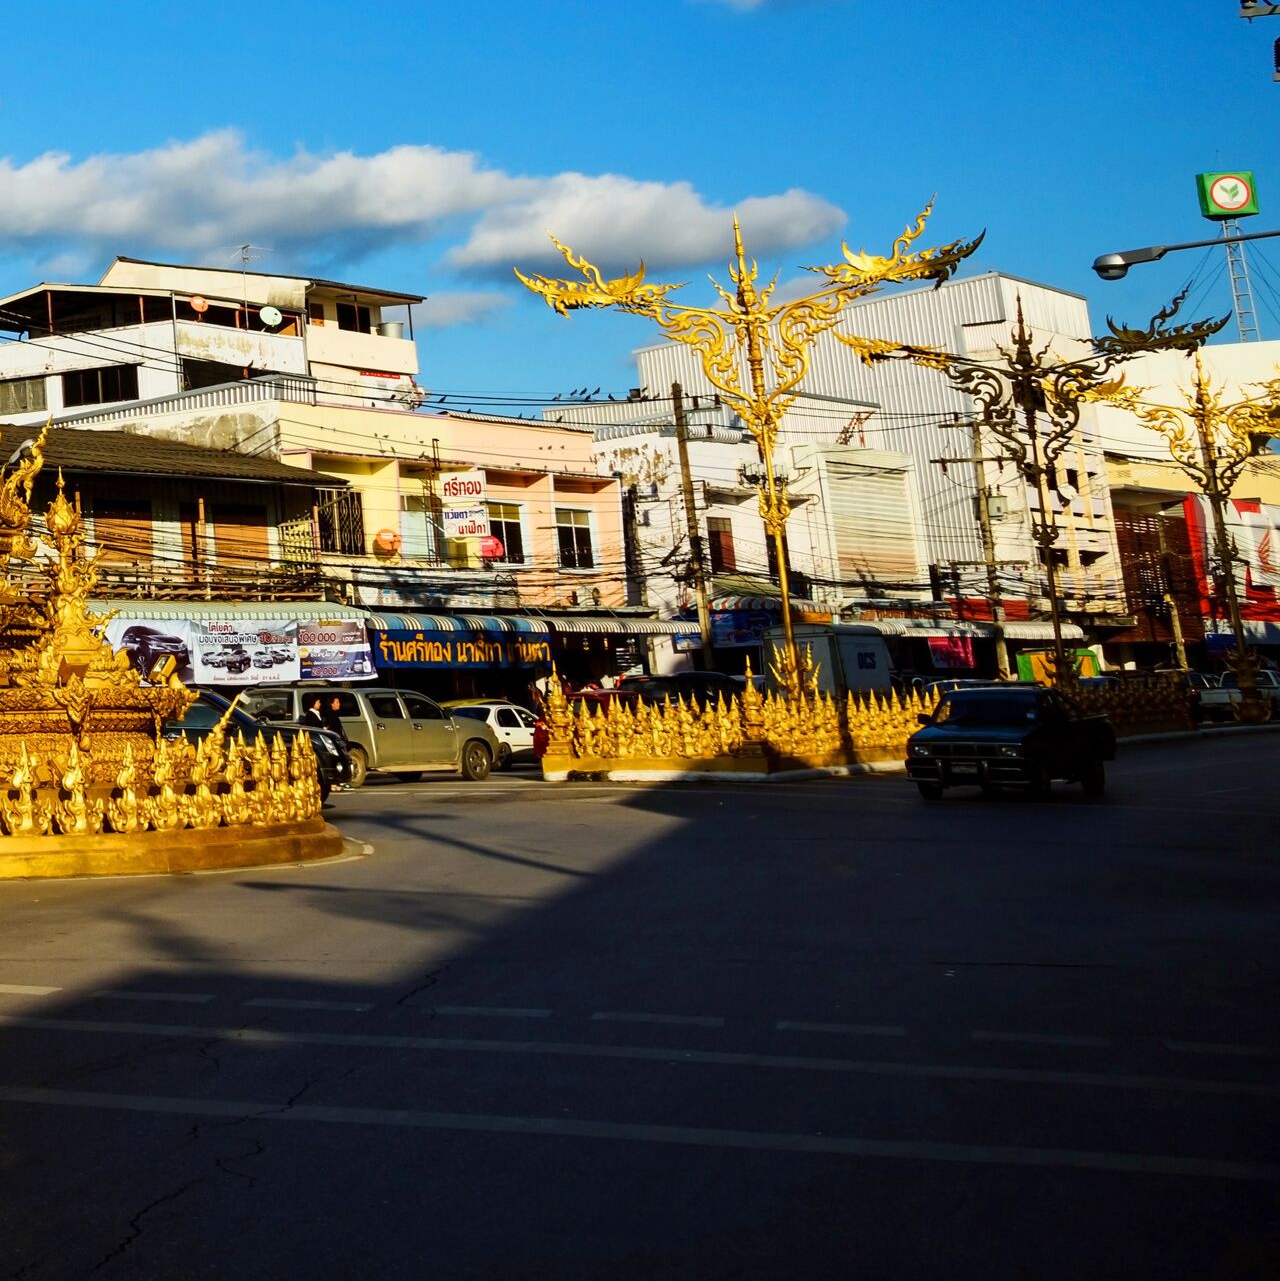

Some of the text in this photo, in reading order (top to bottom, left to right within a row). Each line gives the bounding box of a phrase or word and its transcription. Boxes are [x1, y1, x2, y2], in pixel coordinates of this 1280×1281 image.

[443, 477, 482, 496] ศรีทอง
[444, 509, 468, 520] แว่นตา
[458, 520, 486, 535] นาฬิกา
[379, 633, 452, 662] ร้านศรีทอง
